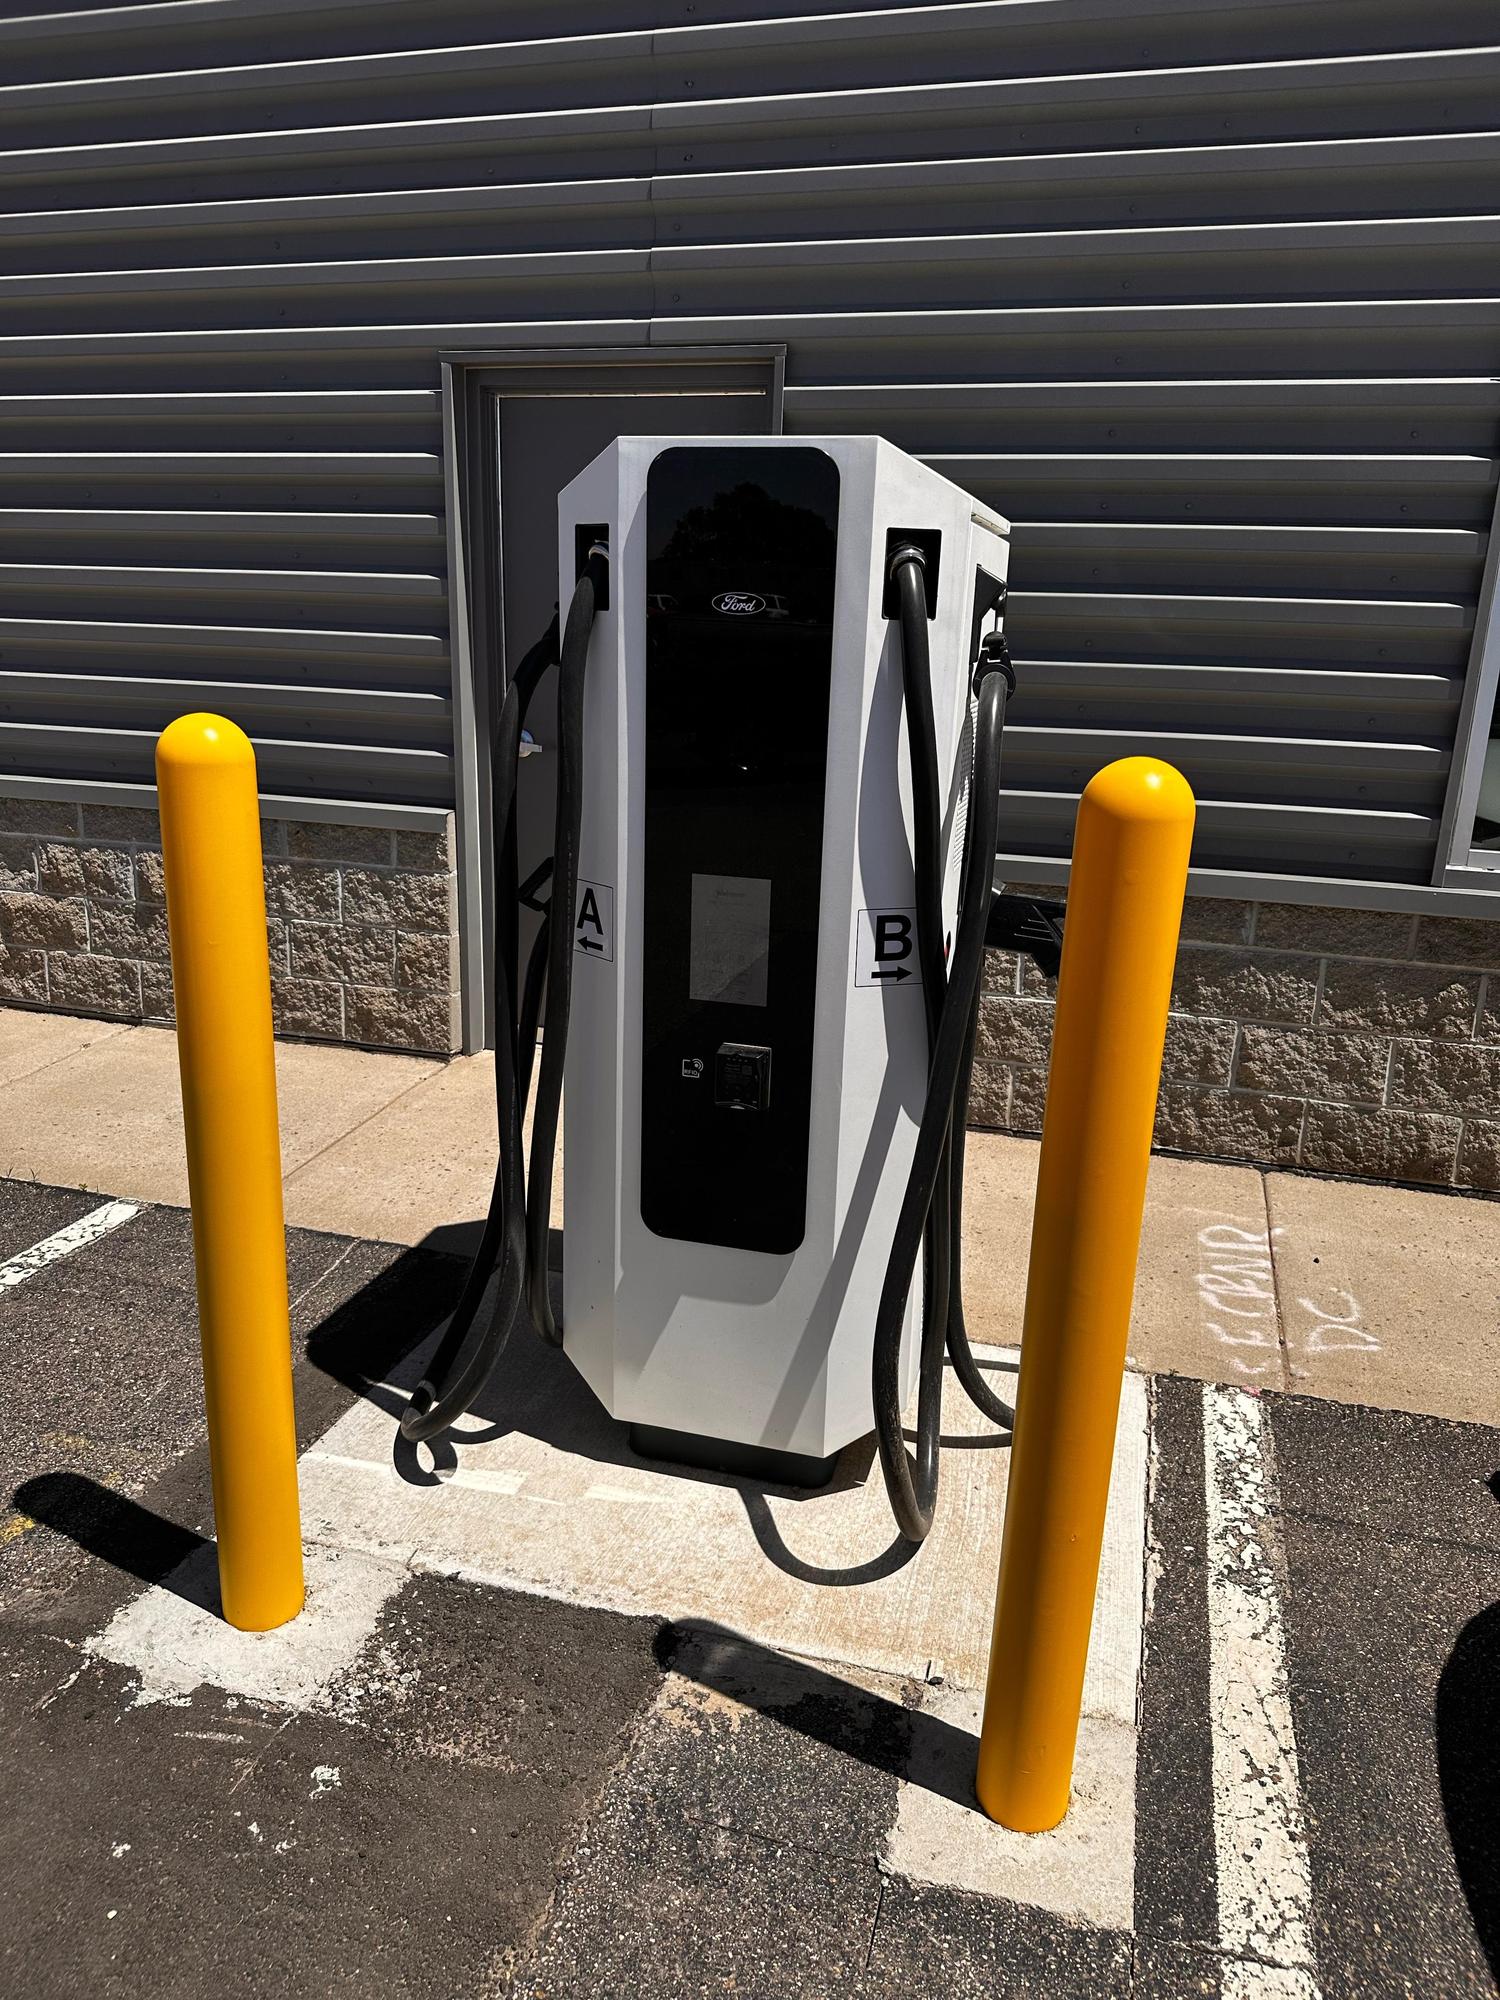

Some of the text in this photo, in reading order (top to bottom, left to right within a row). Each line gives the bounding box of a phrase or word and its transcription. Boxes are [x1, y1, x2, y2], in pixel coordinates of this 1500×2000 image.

[721, 595, 756, 611] Ford
[577, 888, 603, 935] A
[874, 914, 912, 962] B
